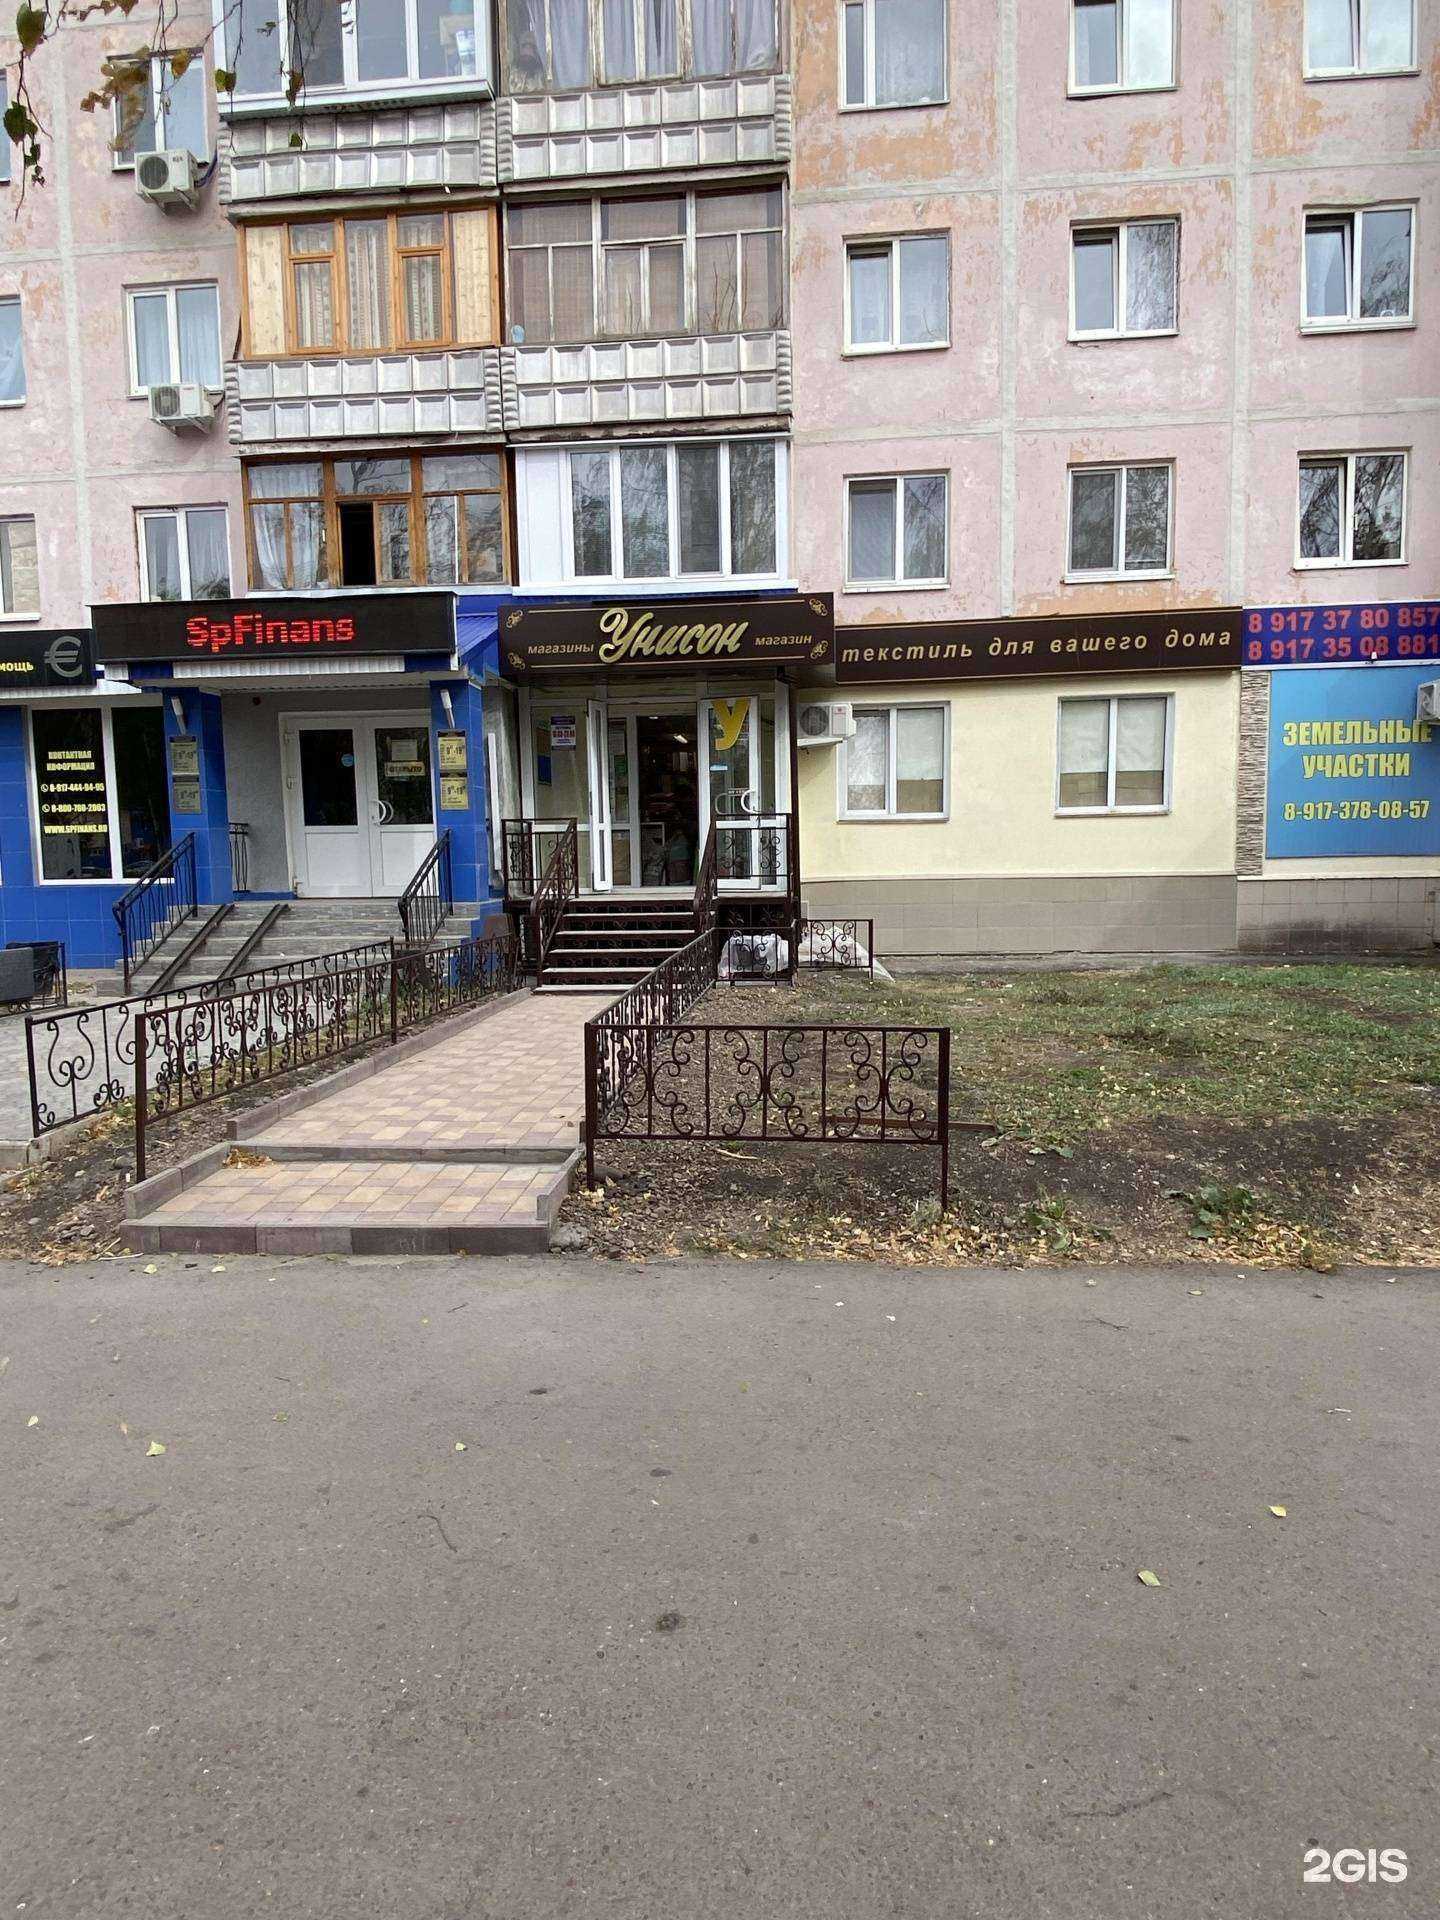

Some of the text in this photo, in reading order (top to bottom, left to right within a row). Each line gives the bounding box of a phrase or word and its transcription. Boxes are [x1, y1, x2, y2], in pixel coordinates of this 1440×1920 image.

[186, 613, 356, 653] SpFinans
[1248, 606, 1440, 633] 8 917 37 80 857
[527, 607, 813, 664] магазины Унисон магазин
[842, 629, 1231, 663] текстиль для вашего дома
[1248, 633, 1440, 660] 8 917 35 08 881
[1282, 720, 1432, 746] ЗЕМЕЛЬНЫЕ
[1302, 753, 1411, 779] УЧАСТКИ
[1283, 800, 1430, 821] 8-917-378-08-57
